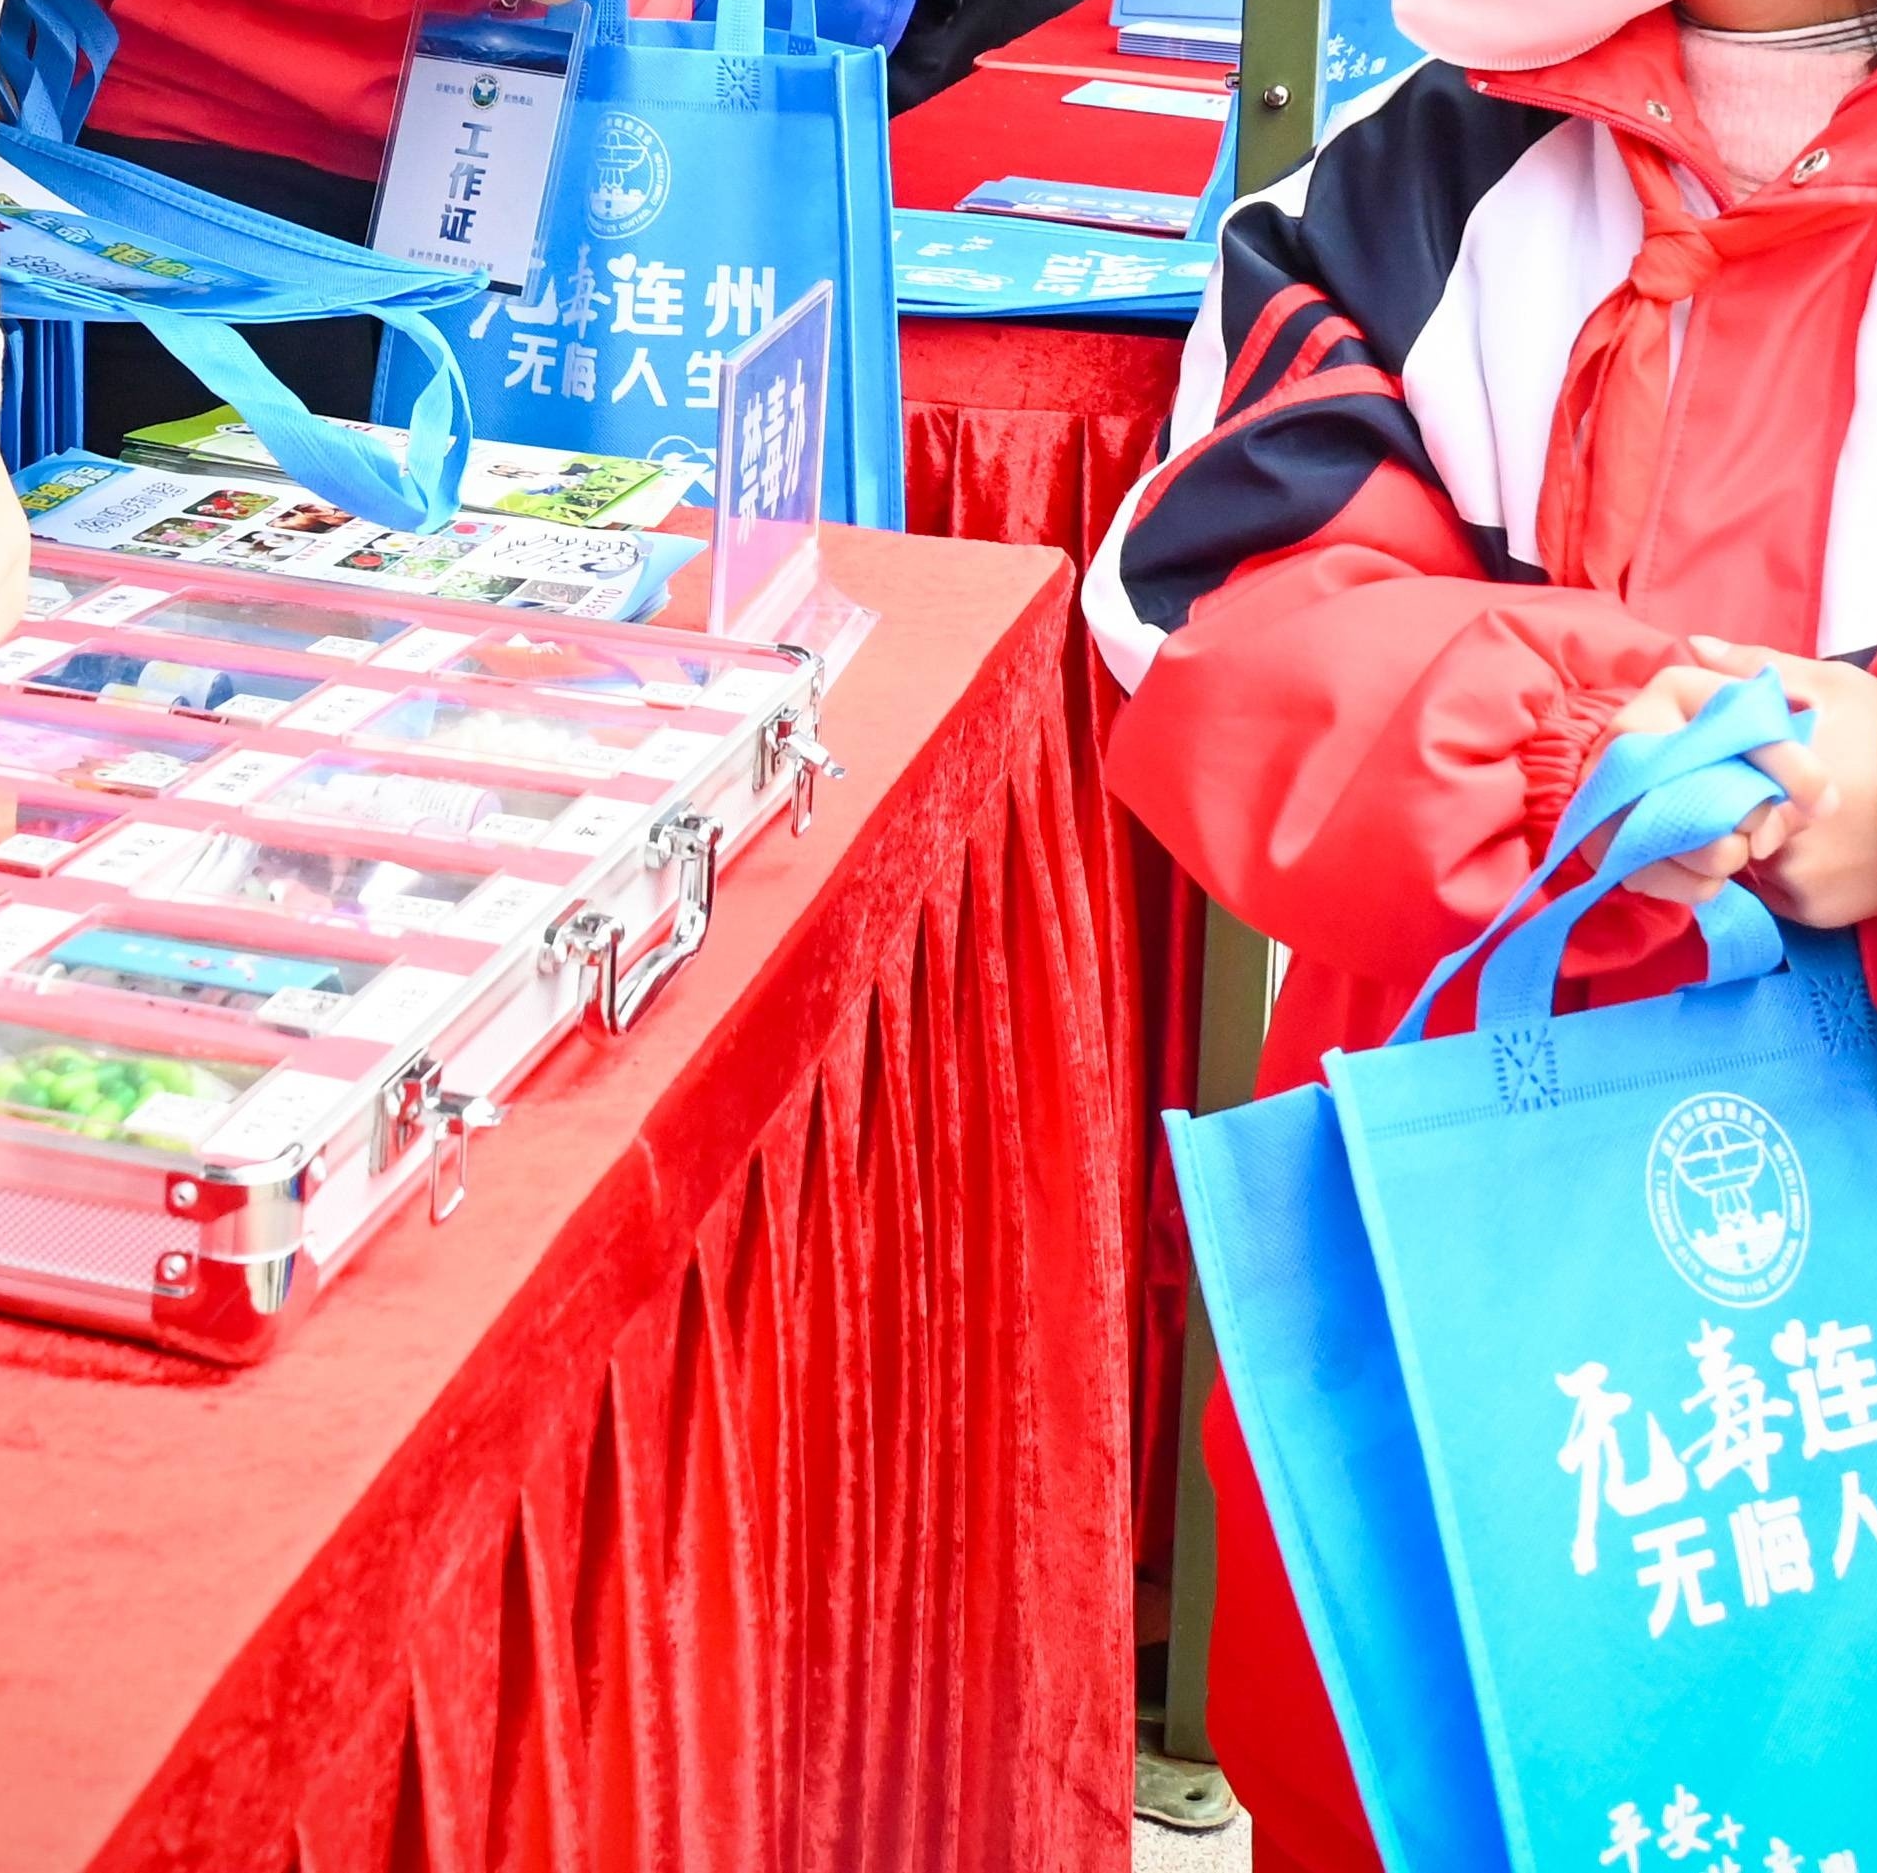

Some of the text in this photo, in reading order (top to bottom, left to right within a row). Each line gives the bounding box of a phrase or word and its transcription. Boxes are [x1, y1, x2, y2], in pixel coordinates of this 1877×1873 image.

[438, 121, 493, 244] 工作证
[503, 333, 723, 411] 无悔人生
[736, 357, 807, 546] 禁毒办
[1598, 1783, 1745, 1873] 平安+
